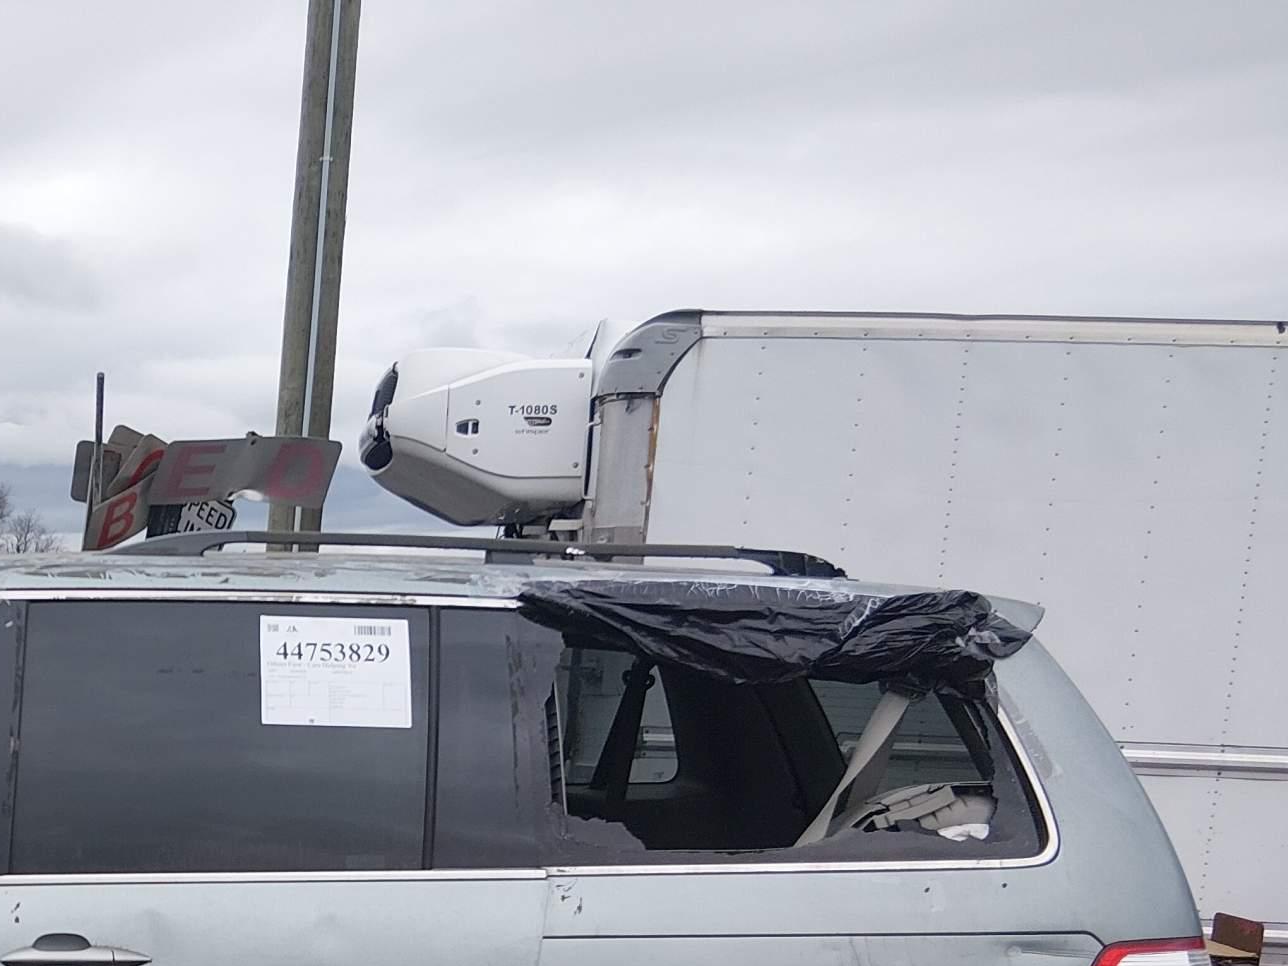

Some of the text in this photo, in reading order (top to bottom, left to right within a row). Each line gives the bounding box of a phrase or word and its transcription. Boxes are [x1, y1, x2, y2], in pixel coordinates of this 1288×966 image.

[508, 404, 558, 416] T-1080S
[97, 492, 138, 548] B
[183, 501, 228, 530] PEED
[275, 641, 391, 664] 44753829
